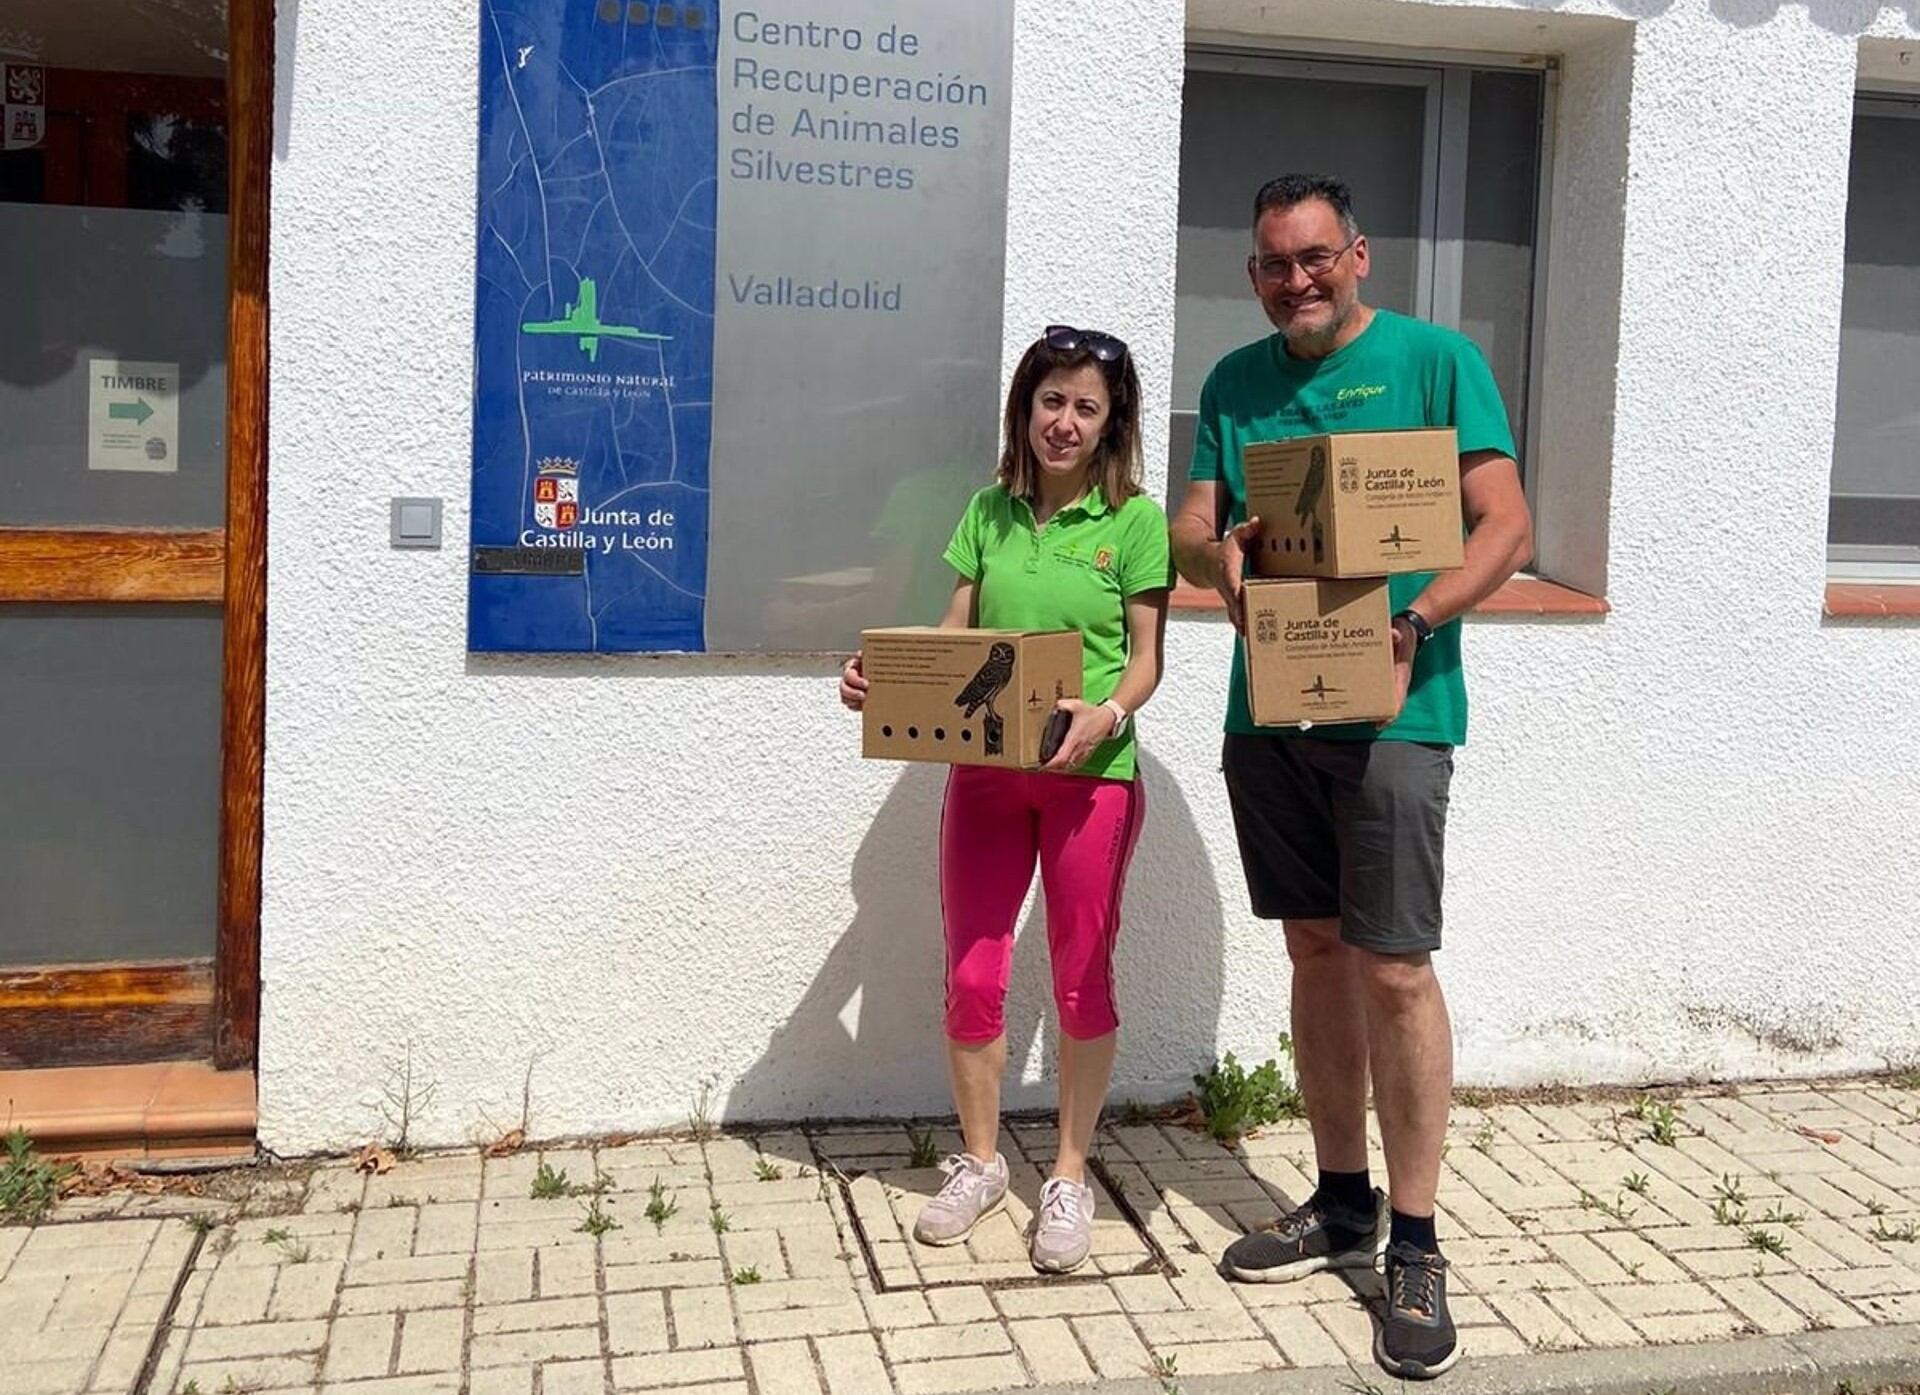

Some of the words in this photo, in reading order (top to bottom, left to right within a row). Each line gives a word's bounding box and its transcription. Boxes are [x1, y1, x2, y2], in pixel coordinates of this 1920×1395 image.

[733, 11, 862, 51] Centro
[877, 24, 919, 56] de
[733, 57, 987, 105] Recuperación
[732, 104, 775, 136] de
[791, 108, 960, 149] Animales
[730, 148, 915, 190] Silvestres
[729, 273, 902, 311] Valladolid
[101, 375, 167, 391] TIMBRE
[1337, 384, 1387, 400] Enrique
[1364, 468, 1397, 480] Junta
[1399, 467, 1415, 478] de
[1364, 479, 1405, 491] Castilla
[1407, 480, 1417, 492] y
[1417, 476, 1445, 488] León
[580, 507, 640, 526] Junta
[648, 509, 675, 527] de
[521, 530, 597, 549] Castilla
[602, 535, 616, 554] y
[622, 531, 674, 550] León
[1284, 619, 1320, 630] Junta
[1322, 618, 1340, 629] de
[1284, 630, 1329, 642] Castilla
[1331, 630, 1341, 642] y
[1343, 627, 1375, 639] León
